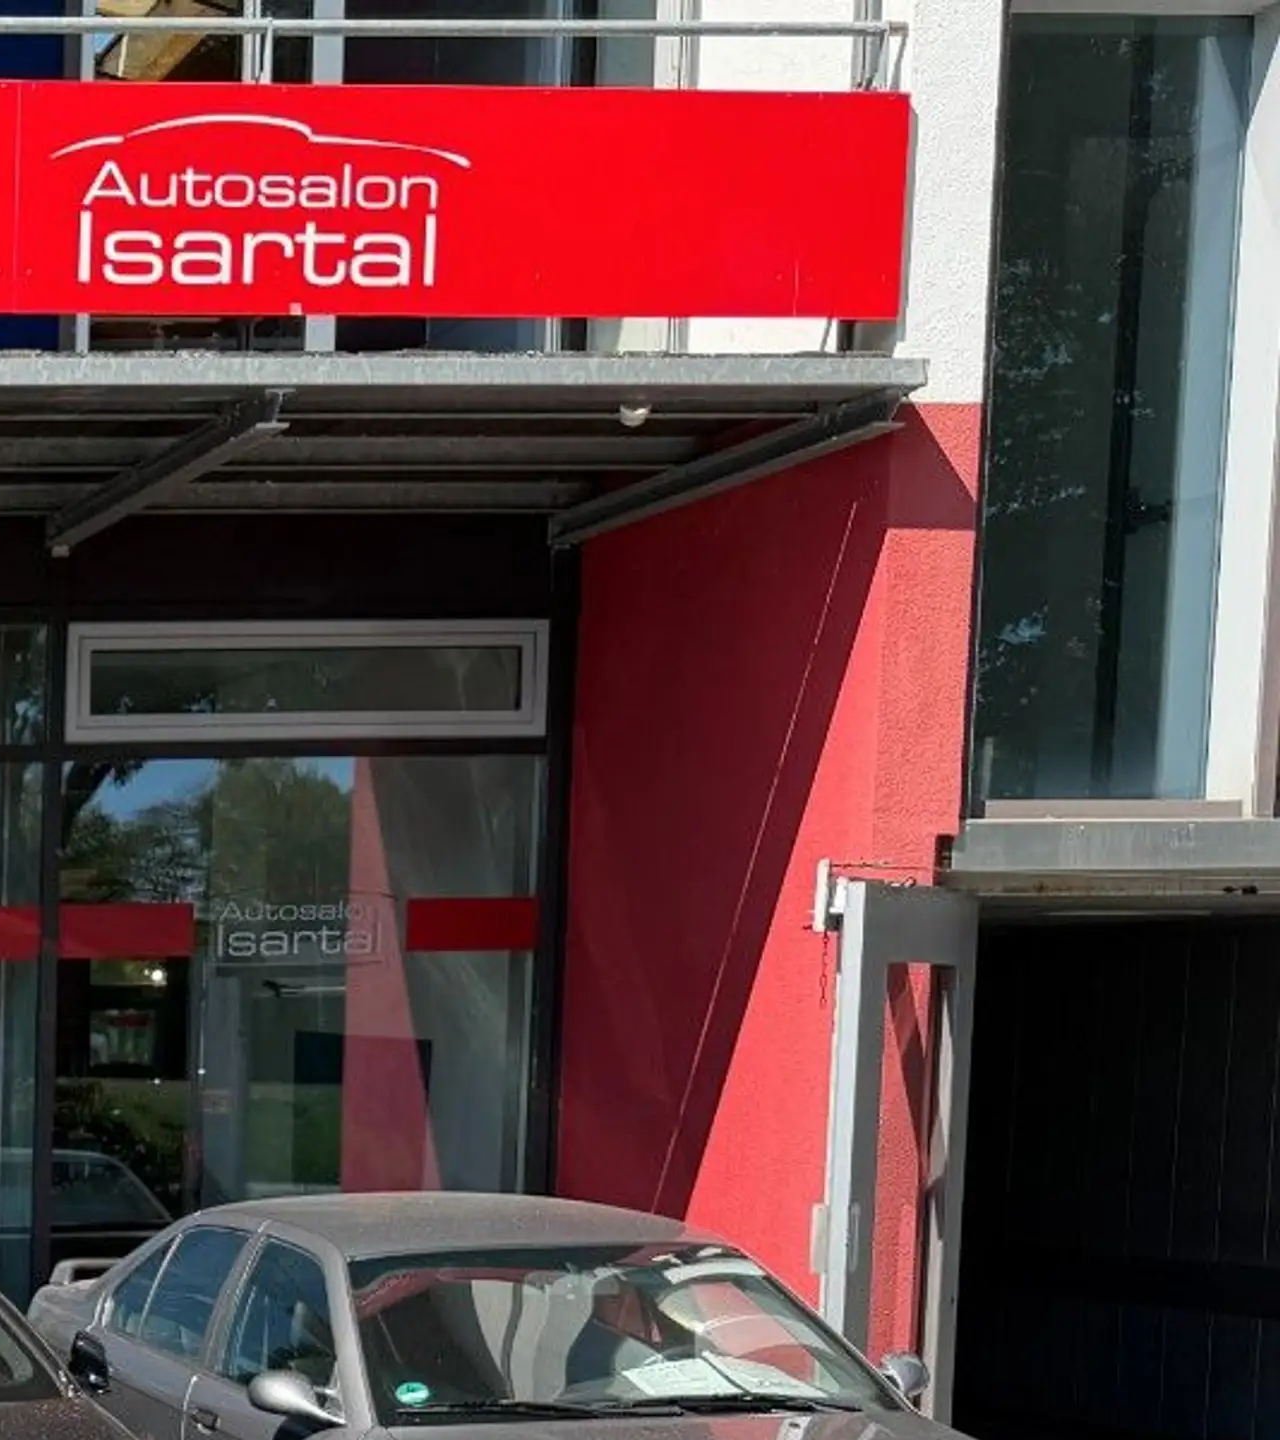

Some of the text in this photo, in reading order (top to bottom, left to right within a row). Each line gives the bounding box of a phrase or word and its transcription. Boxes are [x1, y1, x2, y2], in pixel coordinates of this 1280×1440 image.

[83, 160, 438, 209] Autosalon
[78, 210, 437, 287] Isartal
[217, 923, 382, 957] Isartal
